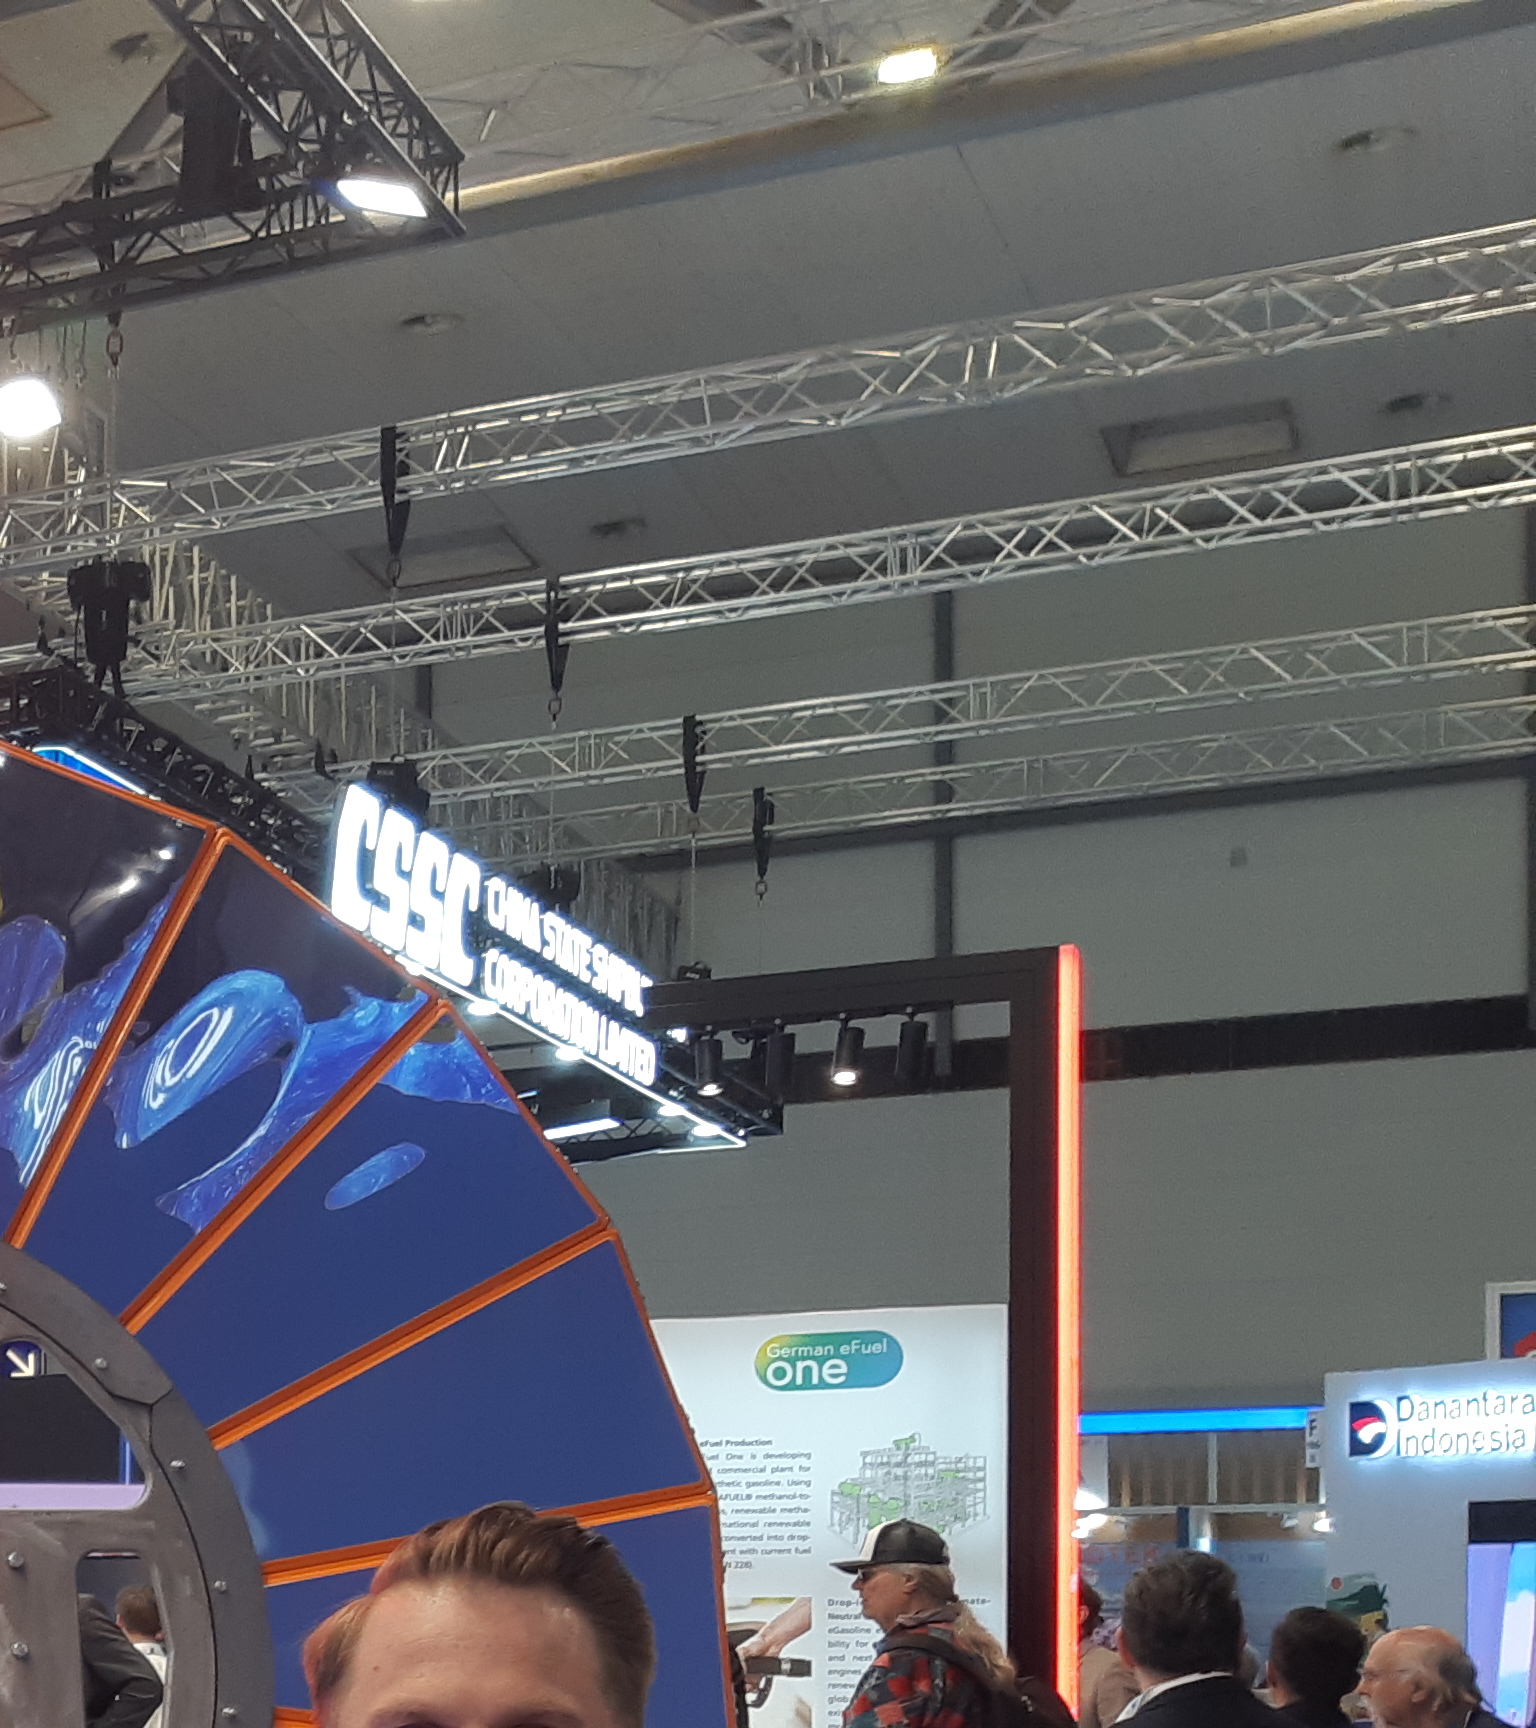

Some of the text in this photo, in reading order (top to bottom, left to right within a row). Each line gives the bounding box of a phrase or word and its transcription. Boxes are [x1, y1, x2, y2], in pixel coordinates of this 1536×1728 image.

[330, 783, 481, 987] CSSC
[599, 1014, 656, 1087] LIMITED
[766, 1337, 888, 1358] German eFuel
[766, 1357, 849, 1387] one
[1396, 1388, 1536, 1423] Danantara
[1396, 1423, 1527, 1457] Indonesia
